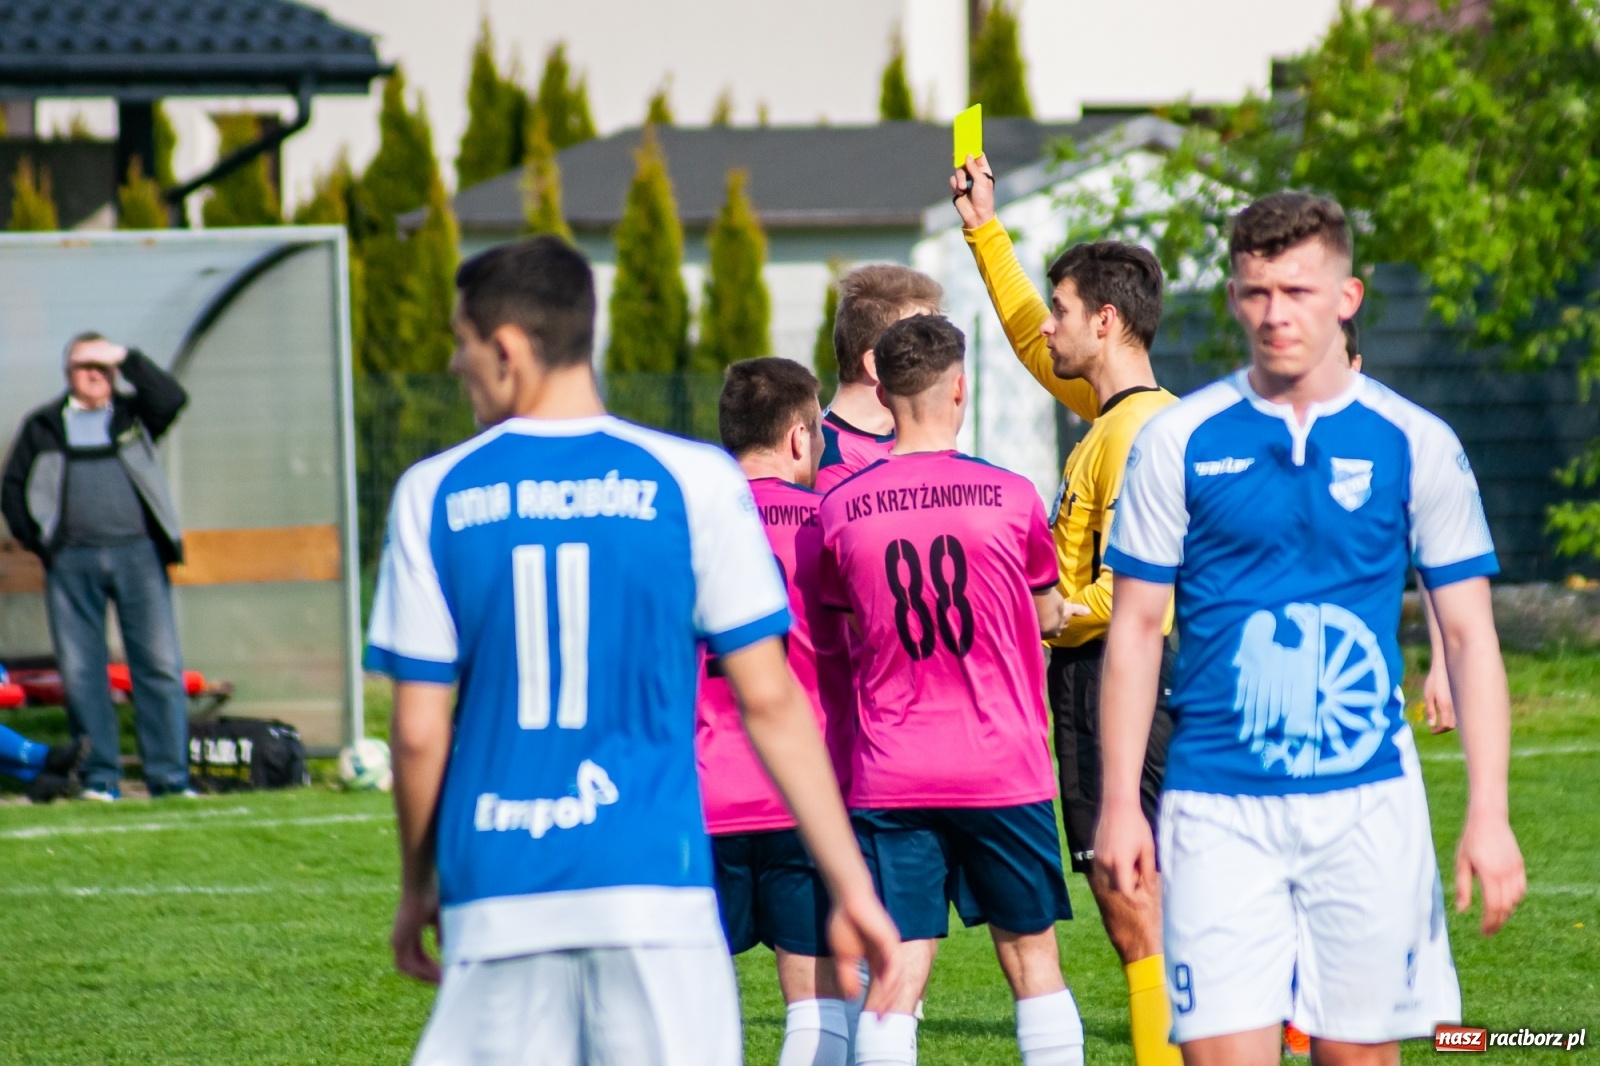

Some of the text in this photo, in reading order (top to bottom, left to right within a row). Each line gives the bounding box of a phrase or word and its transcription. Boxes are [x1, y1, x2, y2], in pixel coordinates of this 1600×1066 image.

[516, 469, 658, 521] RACIBÓRZ
[845, 483, 1003, 522] LKS KRZYŻANOWICE
[885, 534, 974, 662] 88
[512, 542, 590, 730] 11
[1174, 963, 1195, 1015] 9
